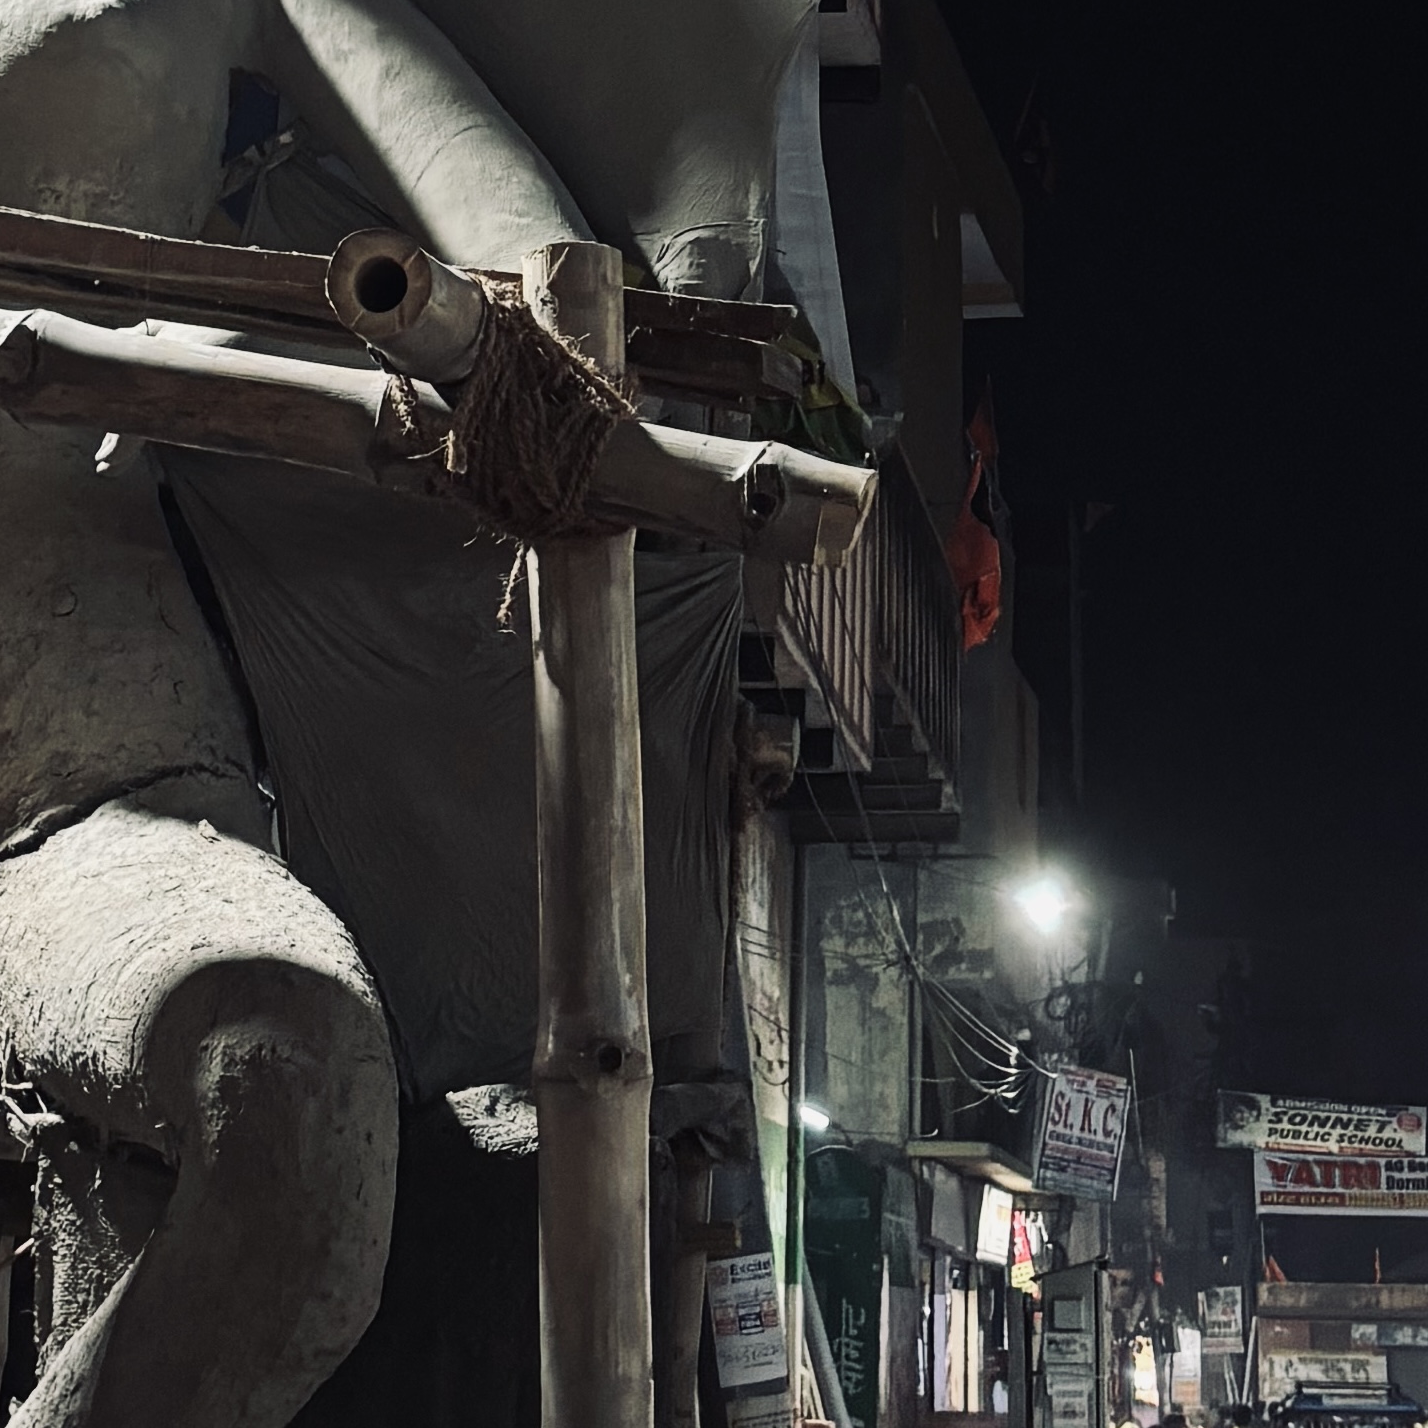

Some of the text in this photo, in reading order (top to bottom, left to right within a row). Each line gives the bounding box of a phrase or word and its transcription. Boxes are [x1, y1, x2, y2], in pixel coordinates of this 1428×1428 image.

[1267, 1126, 1332, 1144] PUBLIC
[1335, 1131, 1405, 1150] SCHOOL
[1265, 1156, 1383, 1190] YATRI
